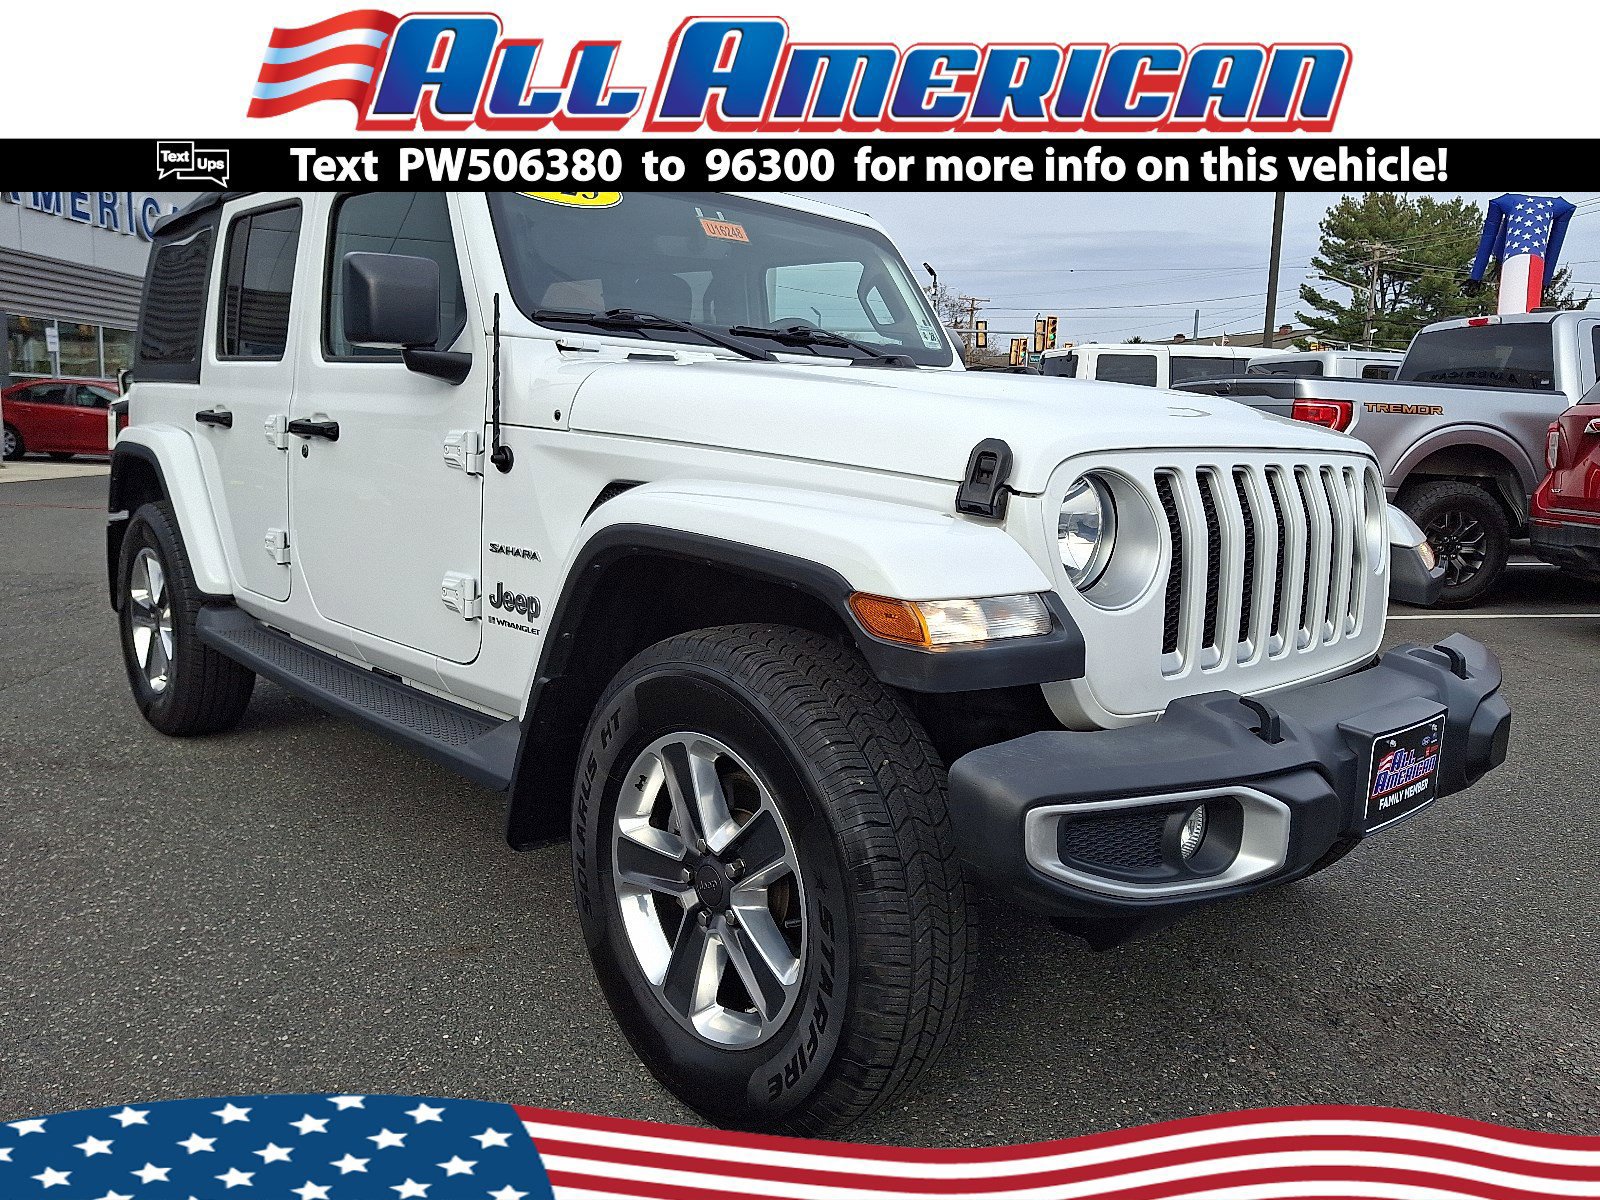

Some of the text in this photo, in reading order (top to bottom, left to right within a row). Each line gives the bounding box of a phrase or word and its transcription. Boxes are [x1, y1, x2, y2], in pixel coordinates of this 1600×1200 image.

[2, 192, 180, 241] MERIC
[706, 223, 744, 239] U16248
[1363, 402, 1444, 416] TREMOR
[489, 543, 541, 562] SAHARA
[489, 582, 541, 623] Jeep
[600, 708, 622, 749] HT
[1378, 778, 1429, 811] FAMILY MEMBER
[767, 900, 837, 1102] STARFIRE
